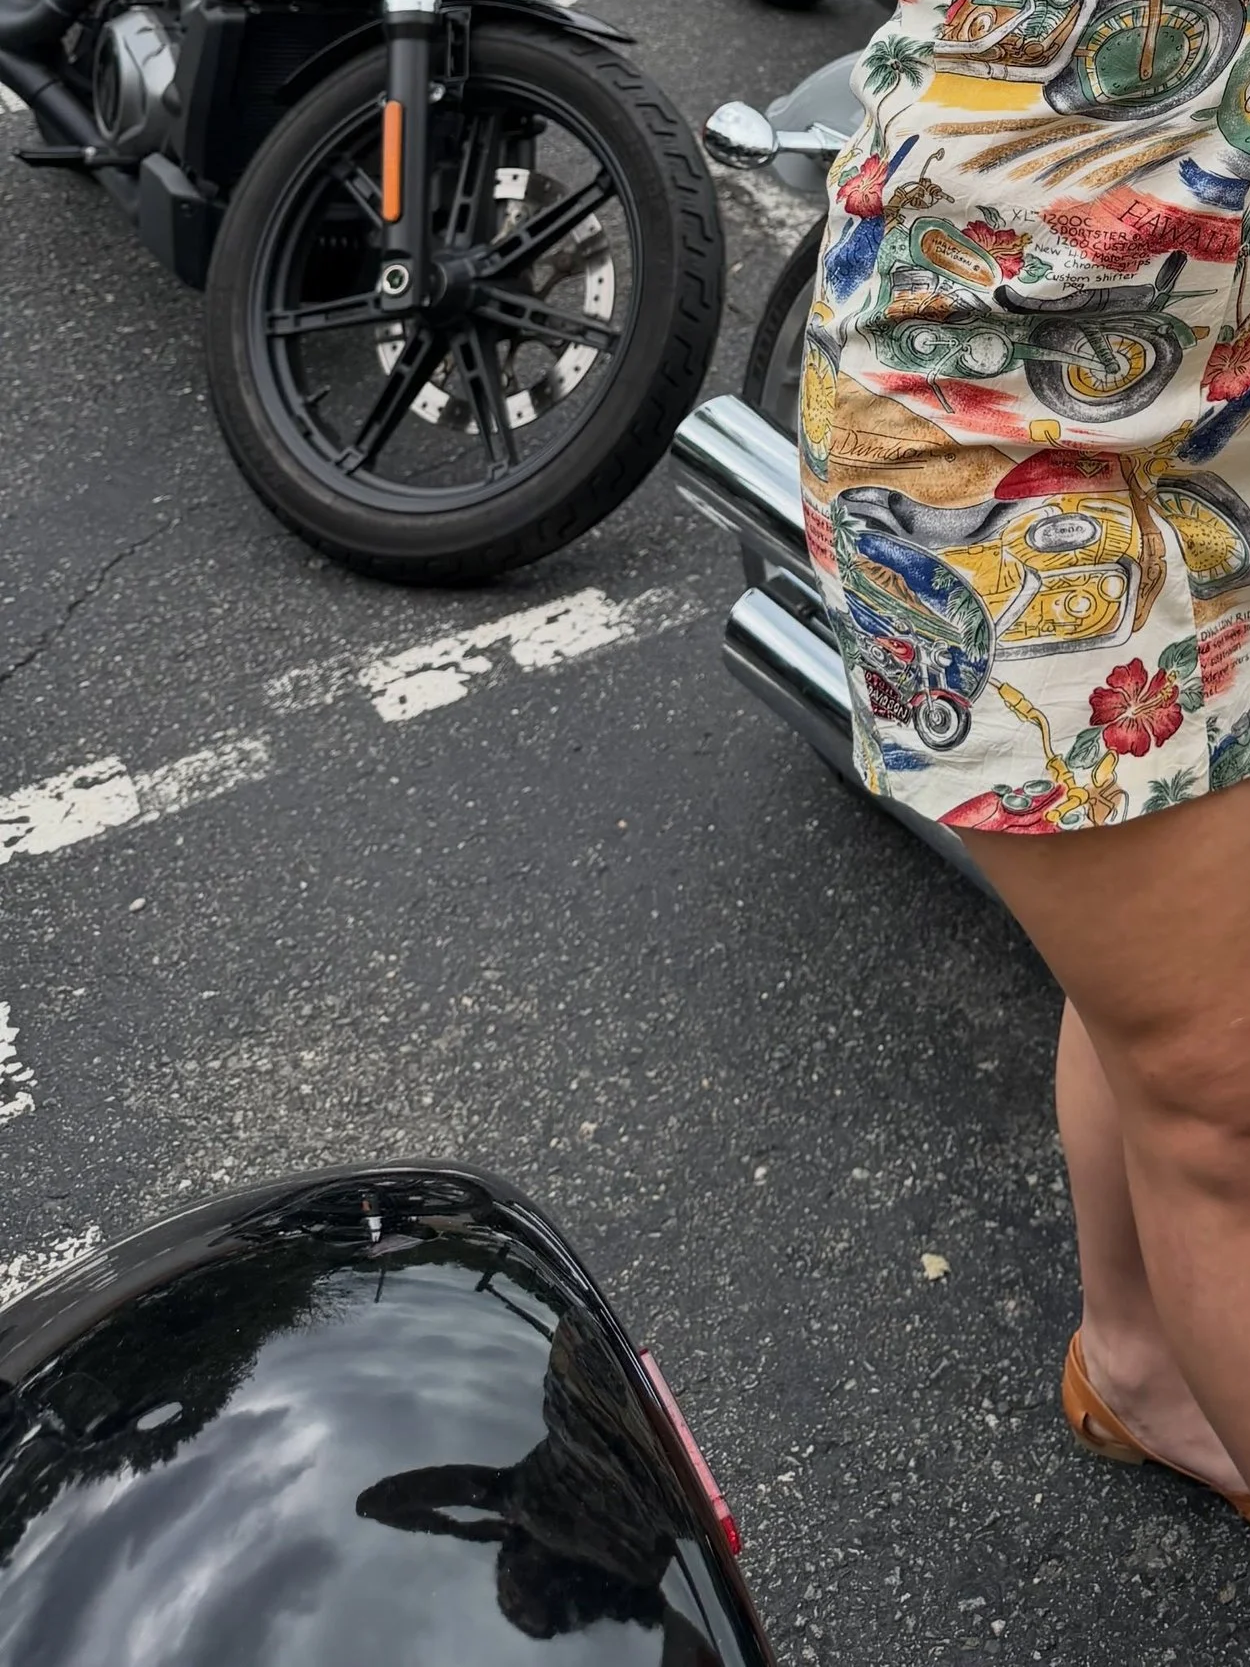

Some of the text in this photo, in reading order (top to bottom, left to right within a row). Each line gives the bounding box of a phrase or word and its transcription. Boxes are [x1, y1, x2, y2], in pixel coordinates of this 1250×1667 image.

[1042, 213, 1093, 227] 1200C
[1117, 199, 1230, 255] HAWAII
[1049, 225, 1127, 241] SPORTSTER
[1034, 244, 1061, 255] New
[1056, 235, 1150, 252] 1200 CUSTOM
[1045, 272, 1090, 282] Custom
